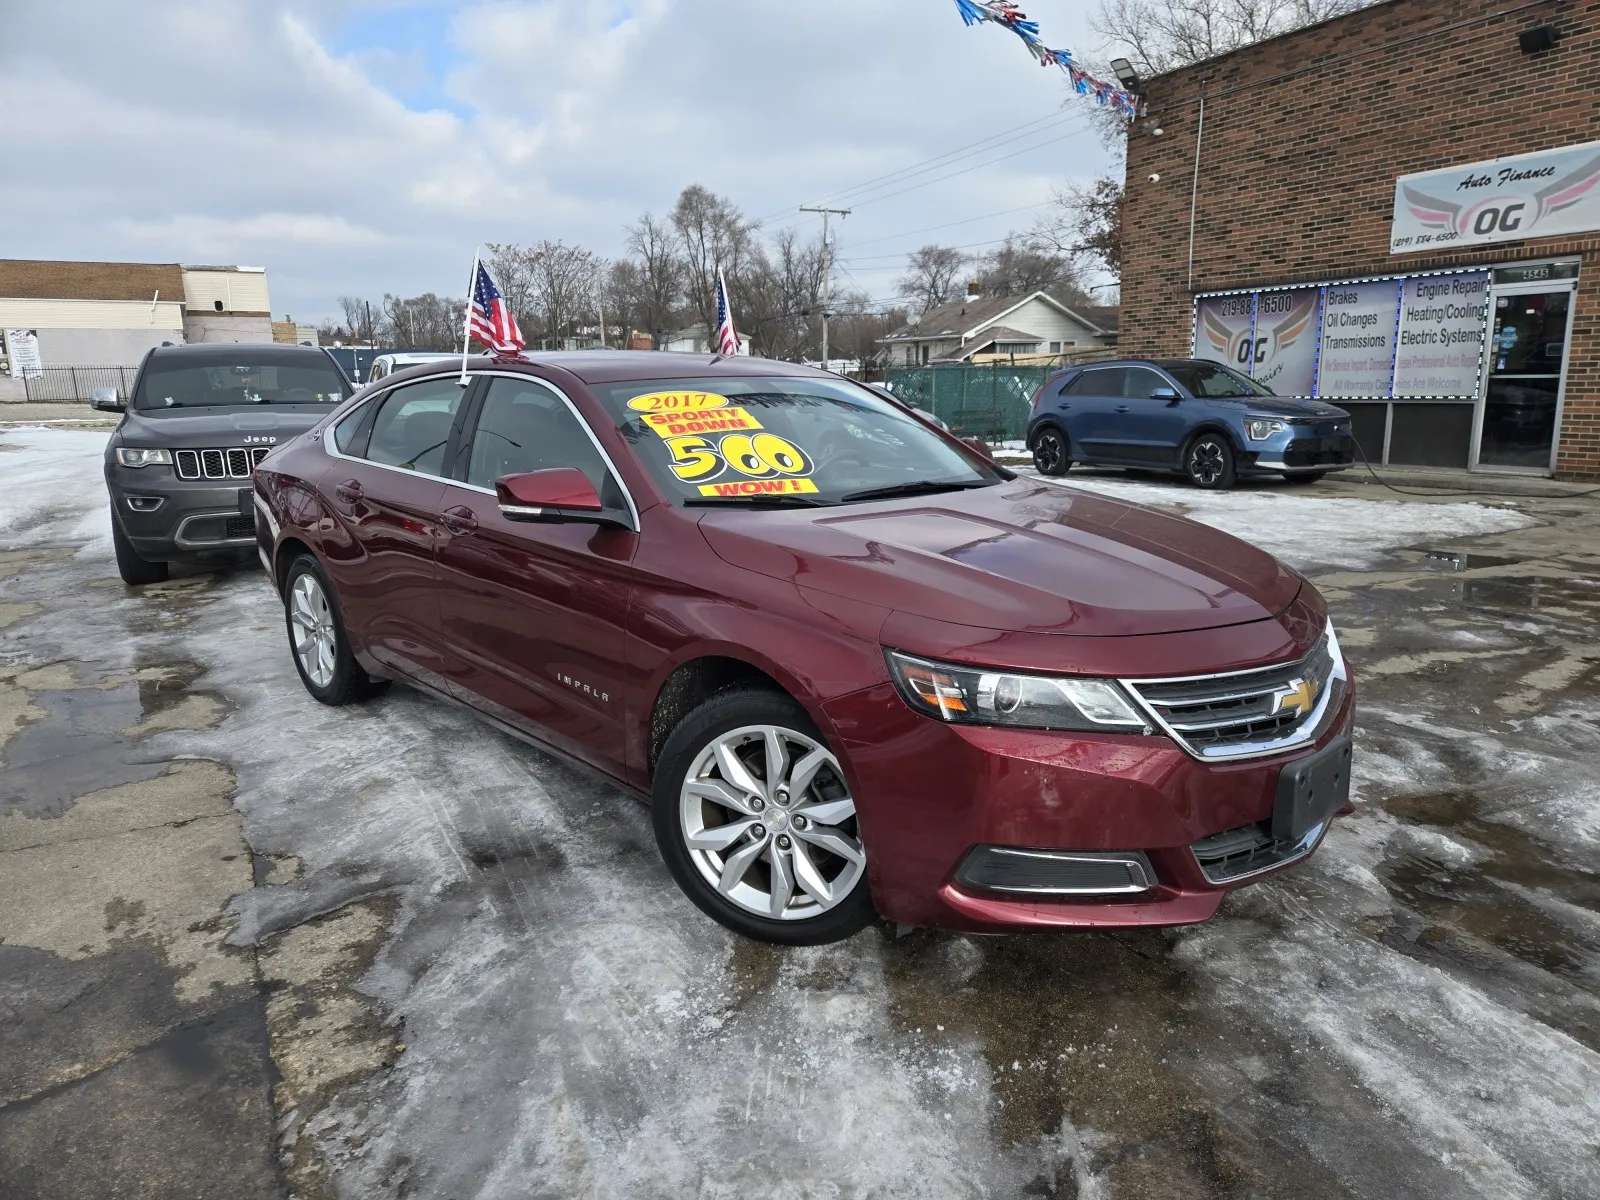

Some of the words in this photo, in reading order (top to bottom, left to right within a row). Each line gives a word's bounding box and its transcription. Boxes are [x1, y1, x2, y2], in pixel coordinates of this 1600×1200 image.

[1456, 173, 1492, 192] Auto
[1497, 165, 1556, 187] Finance
[1474, 203, 1526, 235] OG
[1523, 268, 1549, 279] 4545
[1416, 282, 1451, 301] Engine
[1452, 277, 1486, 297] Repair
[1222, 295, 1292, 316] 219-88-6500
[1328, 291, 1358, 306] Brakes
[1327, 313, 1338, 327] Oil
[1340, 312, 1377, 329] Changes
[1406, 304, 1485, 323] Heating/Cooling
[1325, 335, 1385, 349] Transmissions
[1401, 329, 1437, 345] Electric
[1440, 328, 1482, 347] Systems
[1237, 337, 1268, 363] OG
[1412, 355, 1445, 369] Professional
[1344, 379, 1373, 392] Warranty
[1412, 377, 1426, 389] Are
[1427, 377, 1461, 389] Welcome
[648, 394, 707, 410] 2017
[649, 409, 738, 425] SPORTY
[668, 419, 749, 435] DOWN
[243, 435, 277, 444] Jeep
[663, 433, 815, 484] 500
[557, 672, 609, 702] IMPALA
